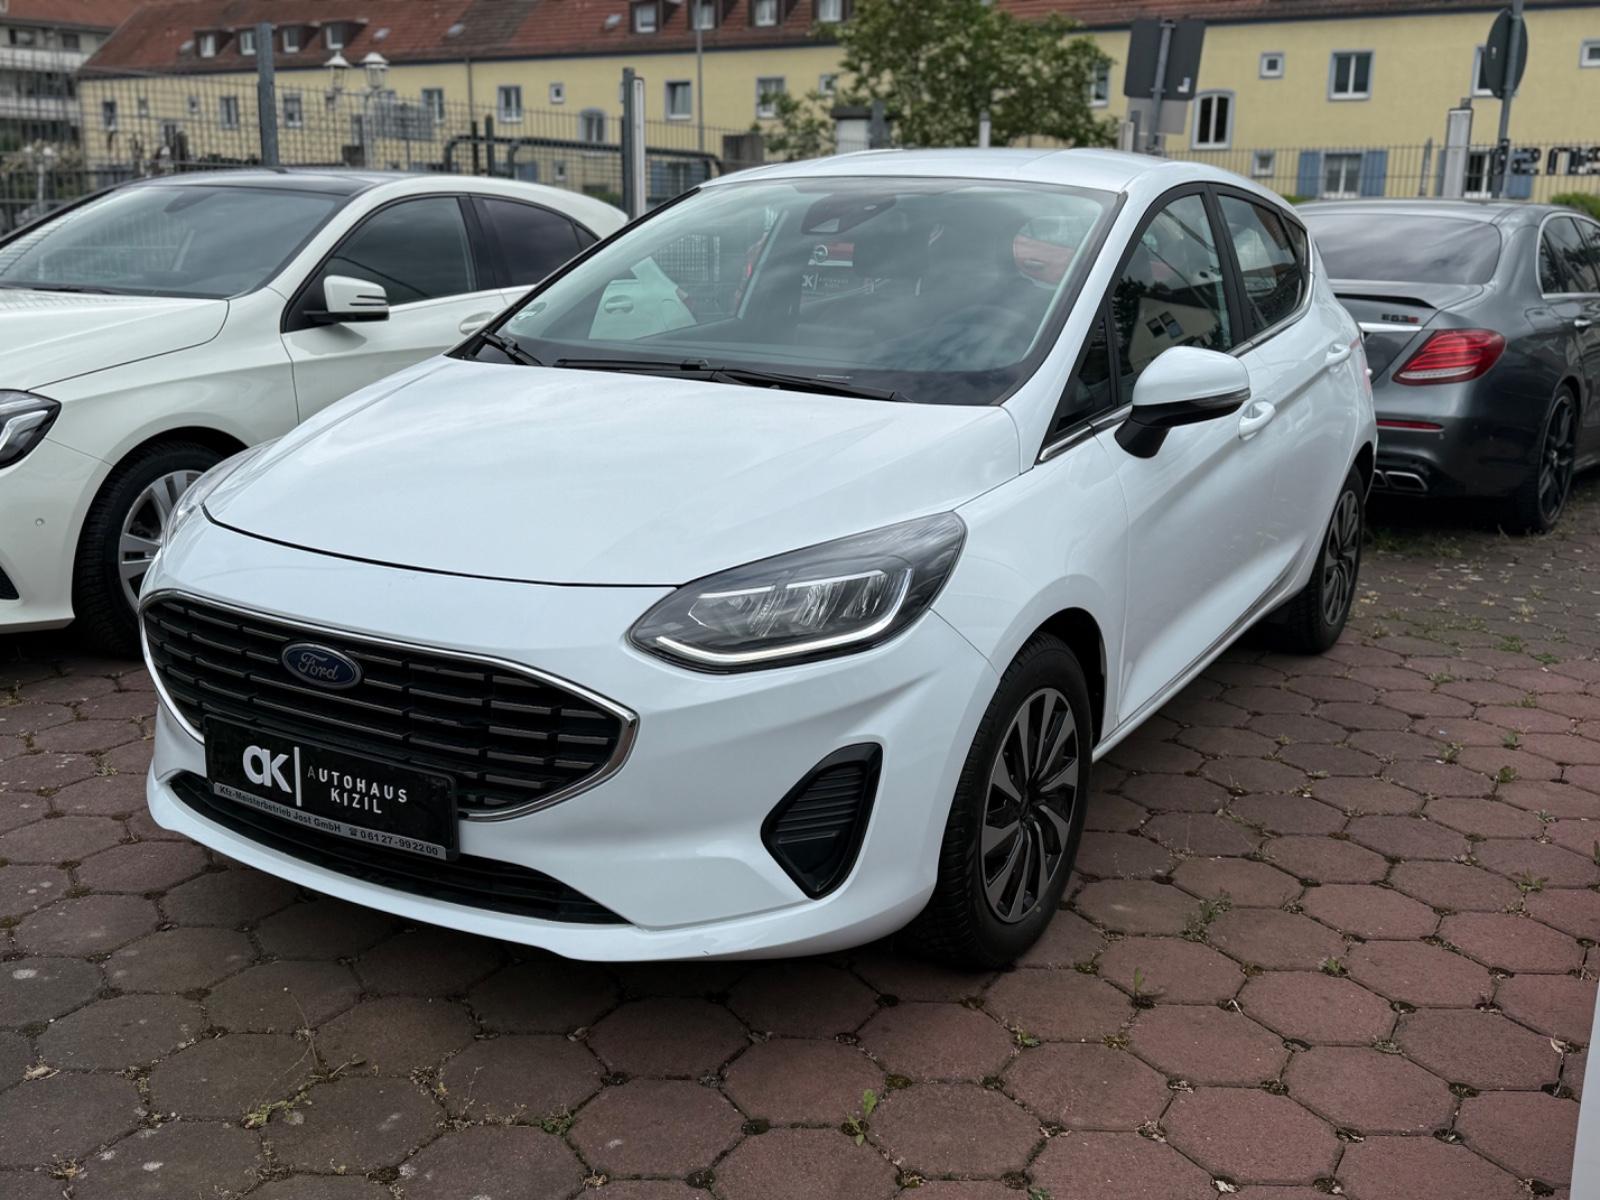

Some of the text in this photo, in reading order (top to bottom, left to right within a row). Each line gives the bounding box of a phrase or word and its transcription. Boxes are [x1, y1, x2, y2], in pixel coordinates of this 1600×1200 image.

[298, 652, 338, 680] Ford
[307, 765, 408, 803] AUTOHAUS
[331, 787, 382, 814] KIZIL
[219, 786, 292, 818] Kfz-Meisterbetrieb
[293, 811, 312, 824] Jost
[314, 817, 341, 833] GmbH
